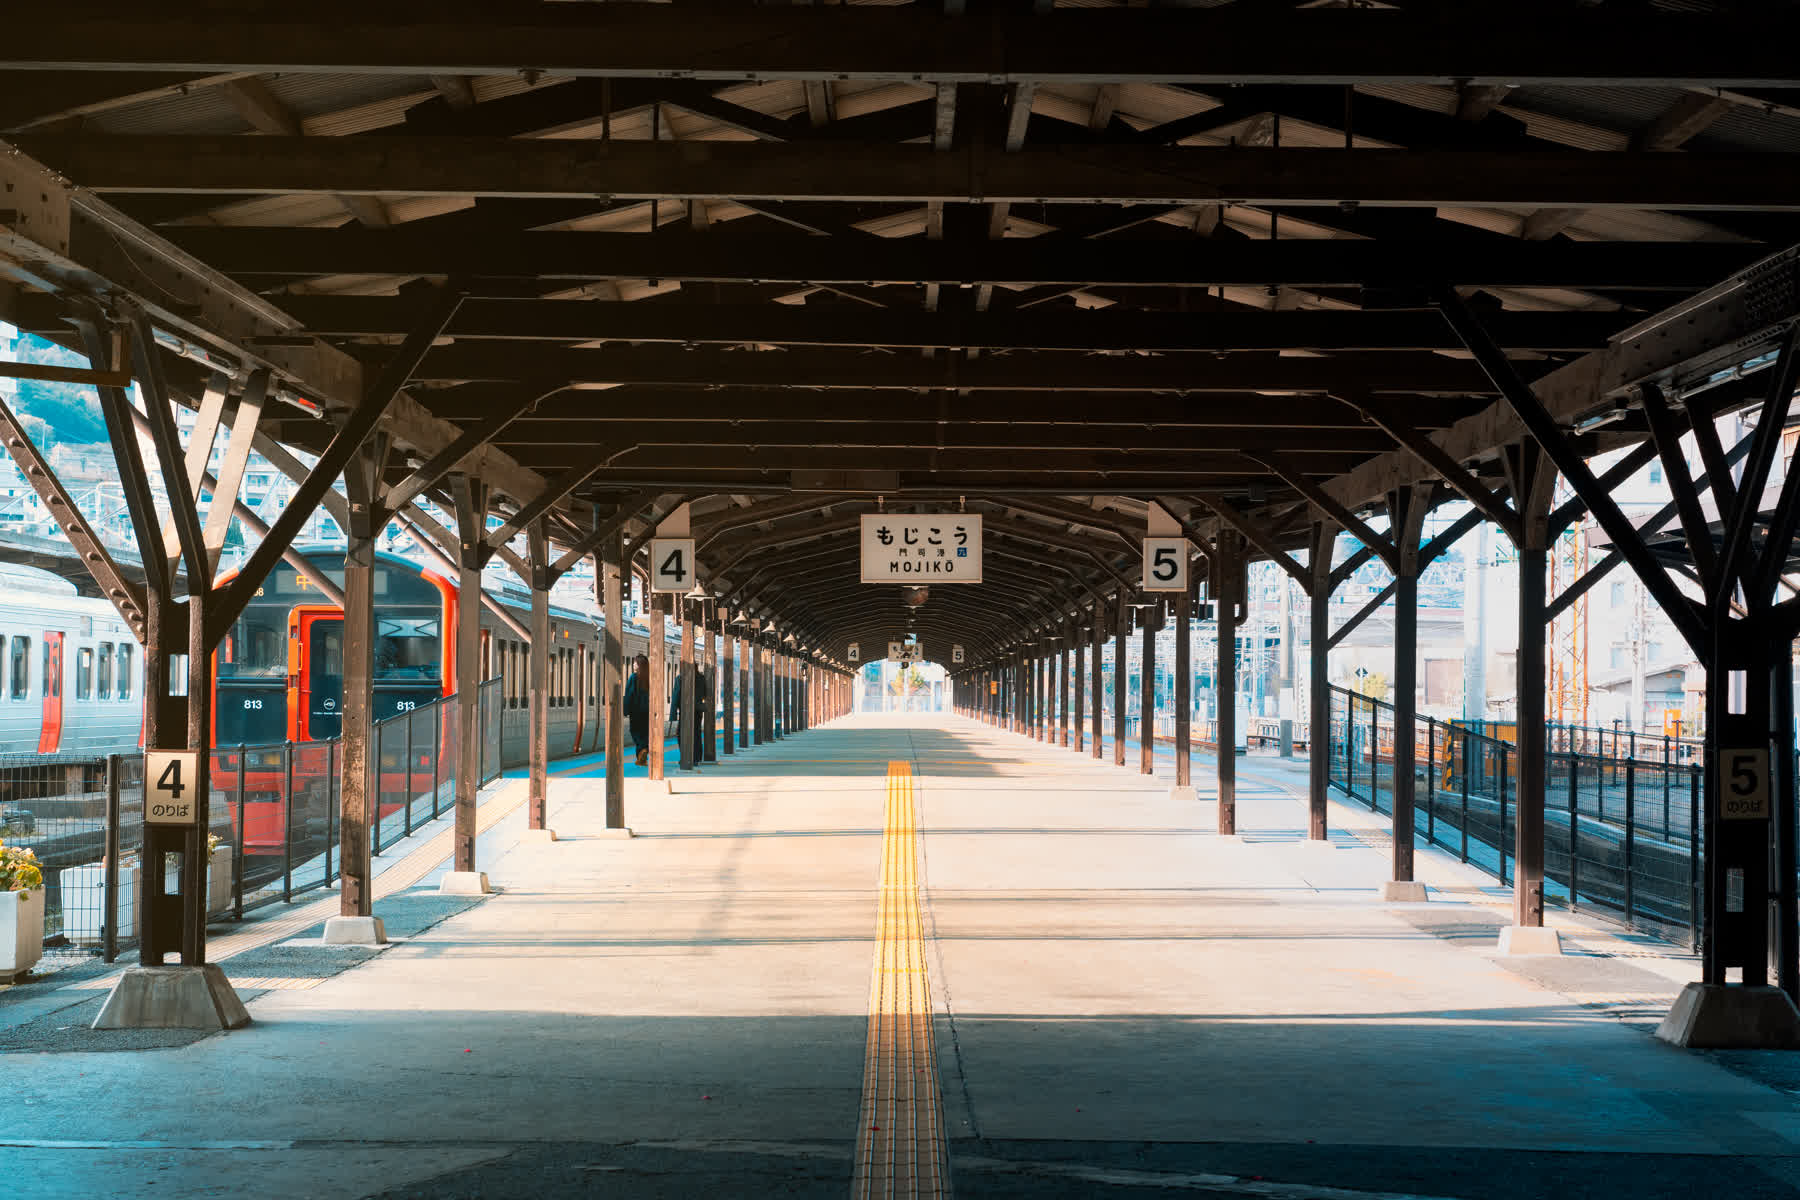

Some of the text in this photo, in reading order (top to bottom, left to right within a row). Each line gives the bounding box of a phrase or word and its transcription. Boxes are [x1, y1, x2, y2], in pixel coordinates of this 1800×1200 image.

[877, 526, 967, 545] もじこう
[660, 549, 686, 582] 4
[1152, 548, 1178, 581] 5
[849, 649, 857, 658] 4
[955, 651, 962, 660] 5
[244, 700, 263, 709] 813
[397, 701, 415, 711] 813
[157, 760, 185, 798] 4
[1730, 756, 1758, 796] 5
[152, 804, 190, 817] のりば
